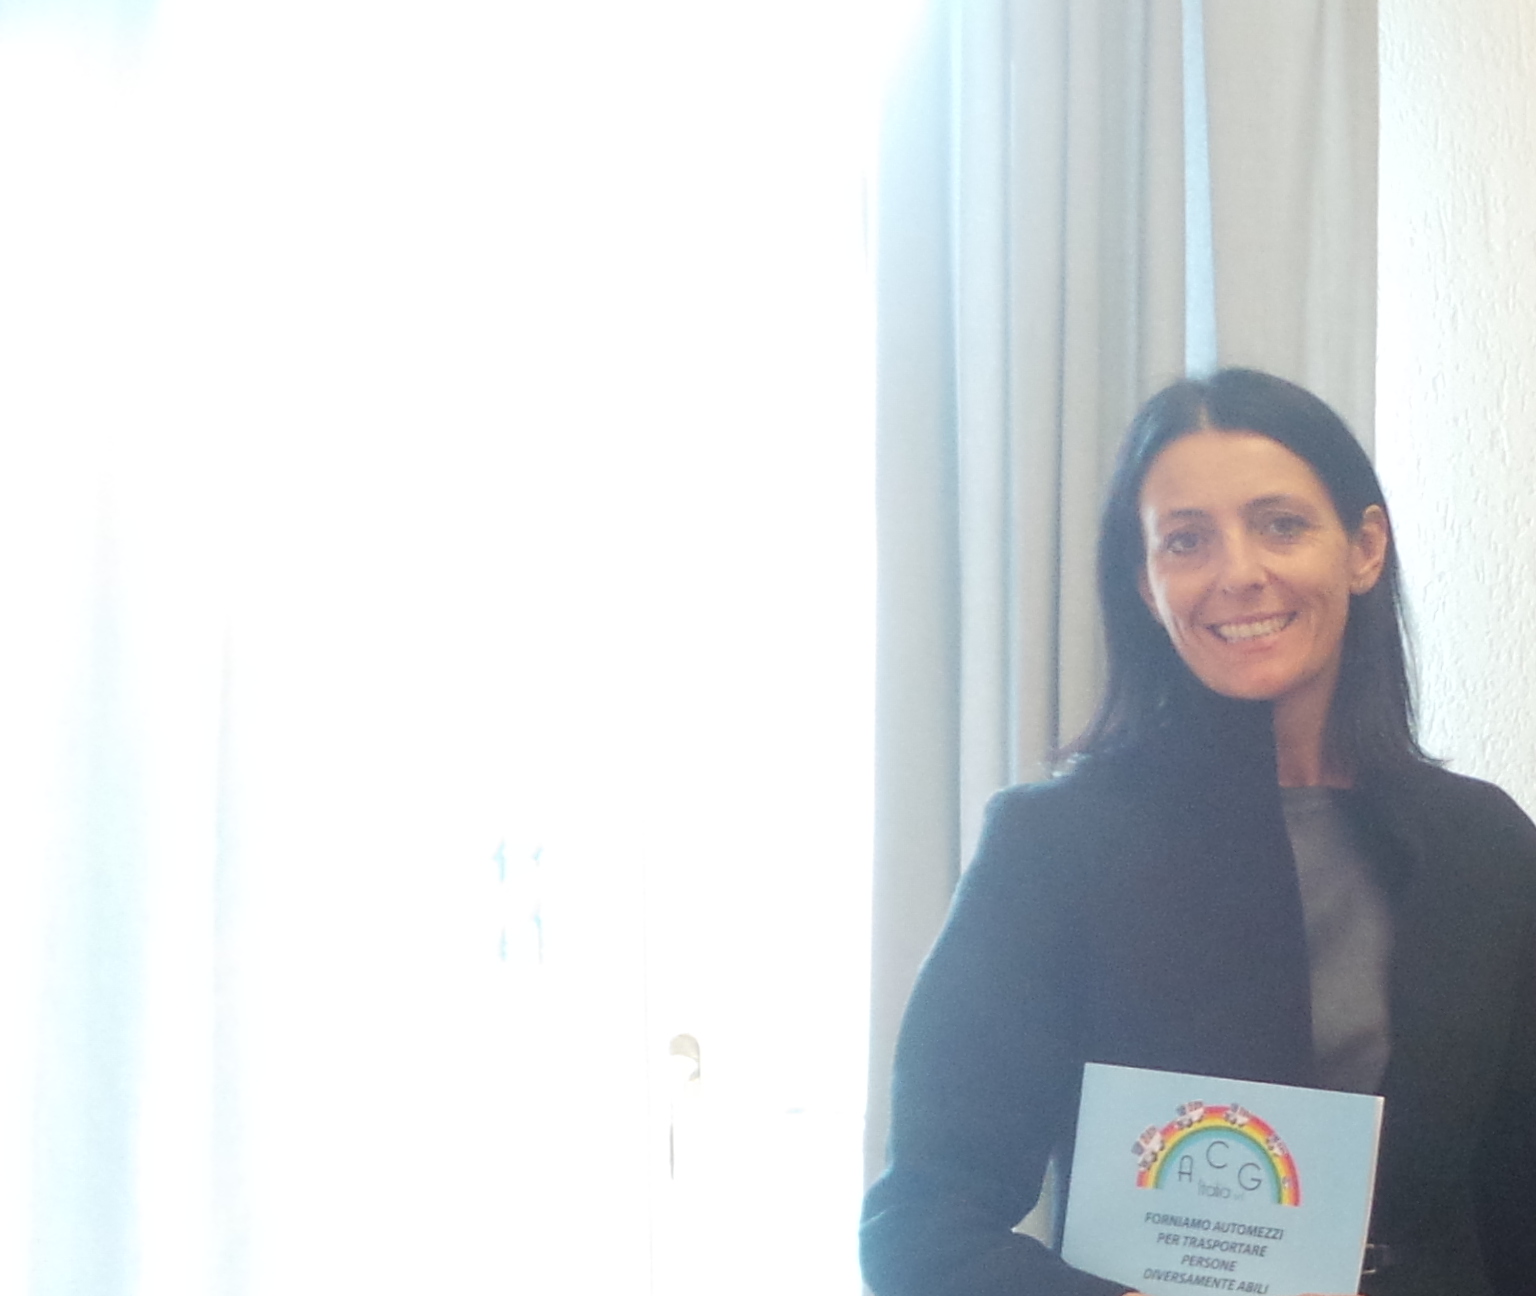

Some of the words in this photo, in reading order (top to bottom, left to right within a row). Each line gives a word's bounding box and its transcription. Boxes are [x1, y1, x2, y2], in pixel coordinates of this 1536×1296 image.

[1144, 1211, 1211, 1231] FORNIAMO
[1212, 1220, 1285, 1241] AUTOMEZZI
[1156, 1231, 1180, 1247] PER
[1181, 1236, 1269, 1258] TRASPORTARE
[1180, 1254, 1238, 1272] PERSONE
[1143, 1268, 1236, 1291] DIVERSAMENTE
[1236, 1281, 1270, 1296] ABILI
